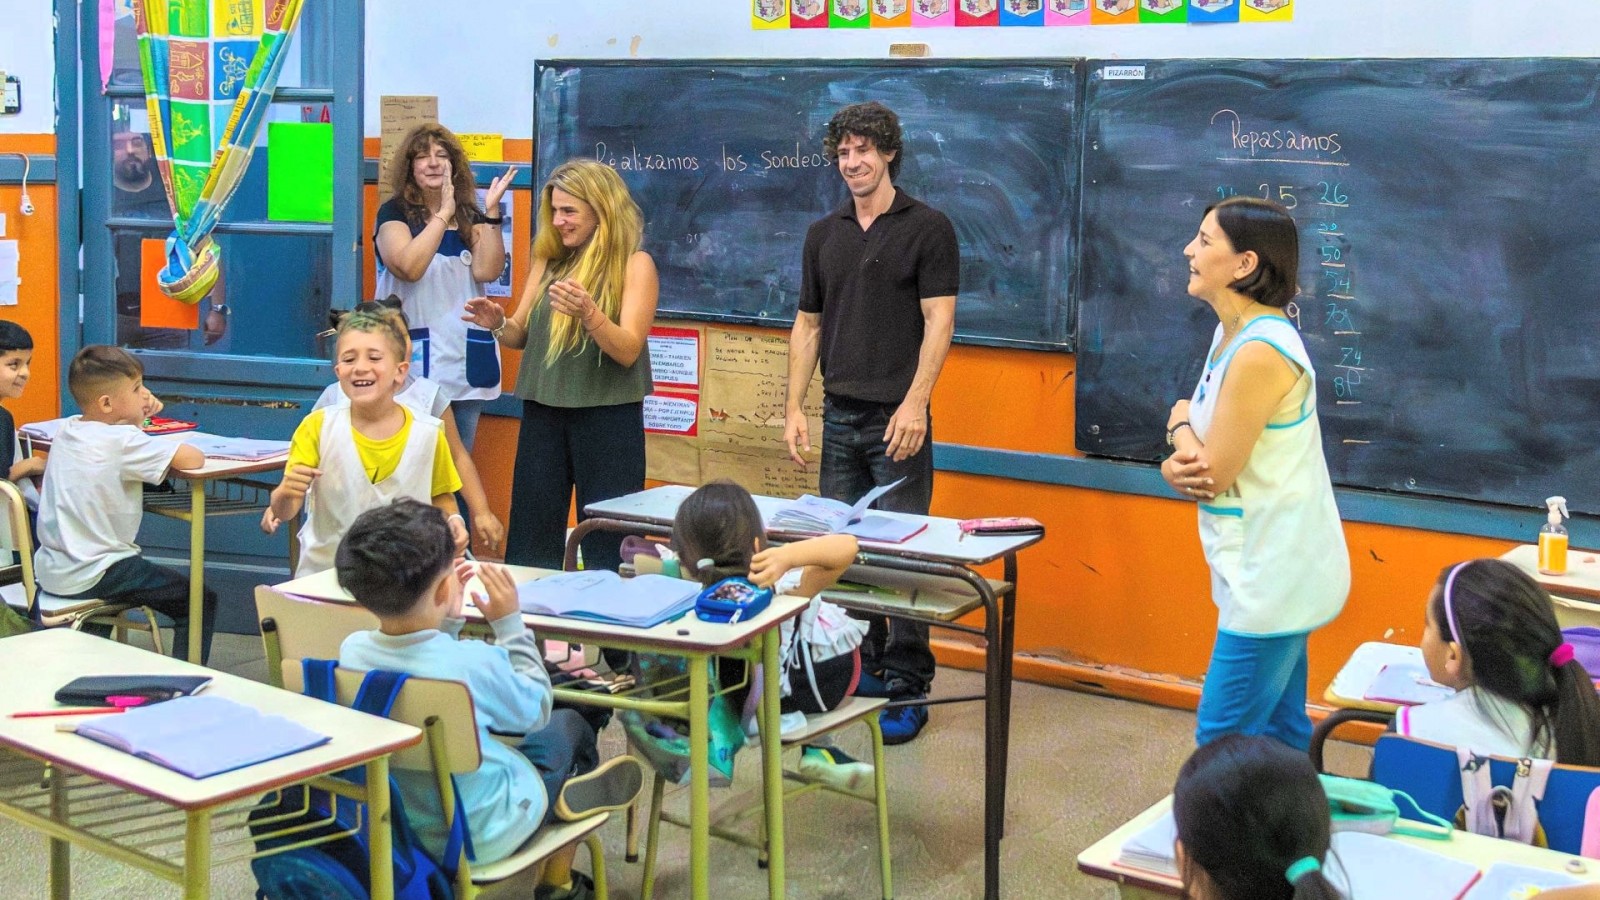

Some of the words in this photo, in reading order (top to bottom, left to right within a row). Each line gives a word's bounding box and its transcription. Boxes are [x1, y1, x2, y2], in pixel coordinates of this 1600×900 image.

[1108, 69, 1144, 77] PIZARRÓN
[1211, 109, 1341, 156] Repasamos
[722, 142, 747, 172] los
[1317, 181, 1348, 204] 26
[1321, 245, 1341, 263] 50
[1339, 347, 1362, 366] 74
